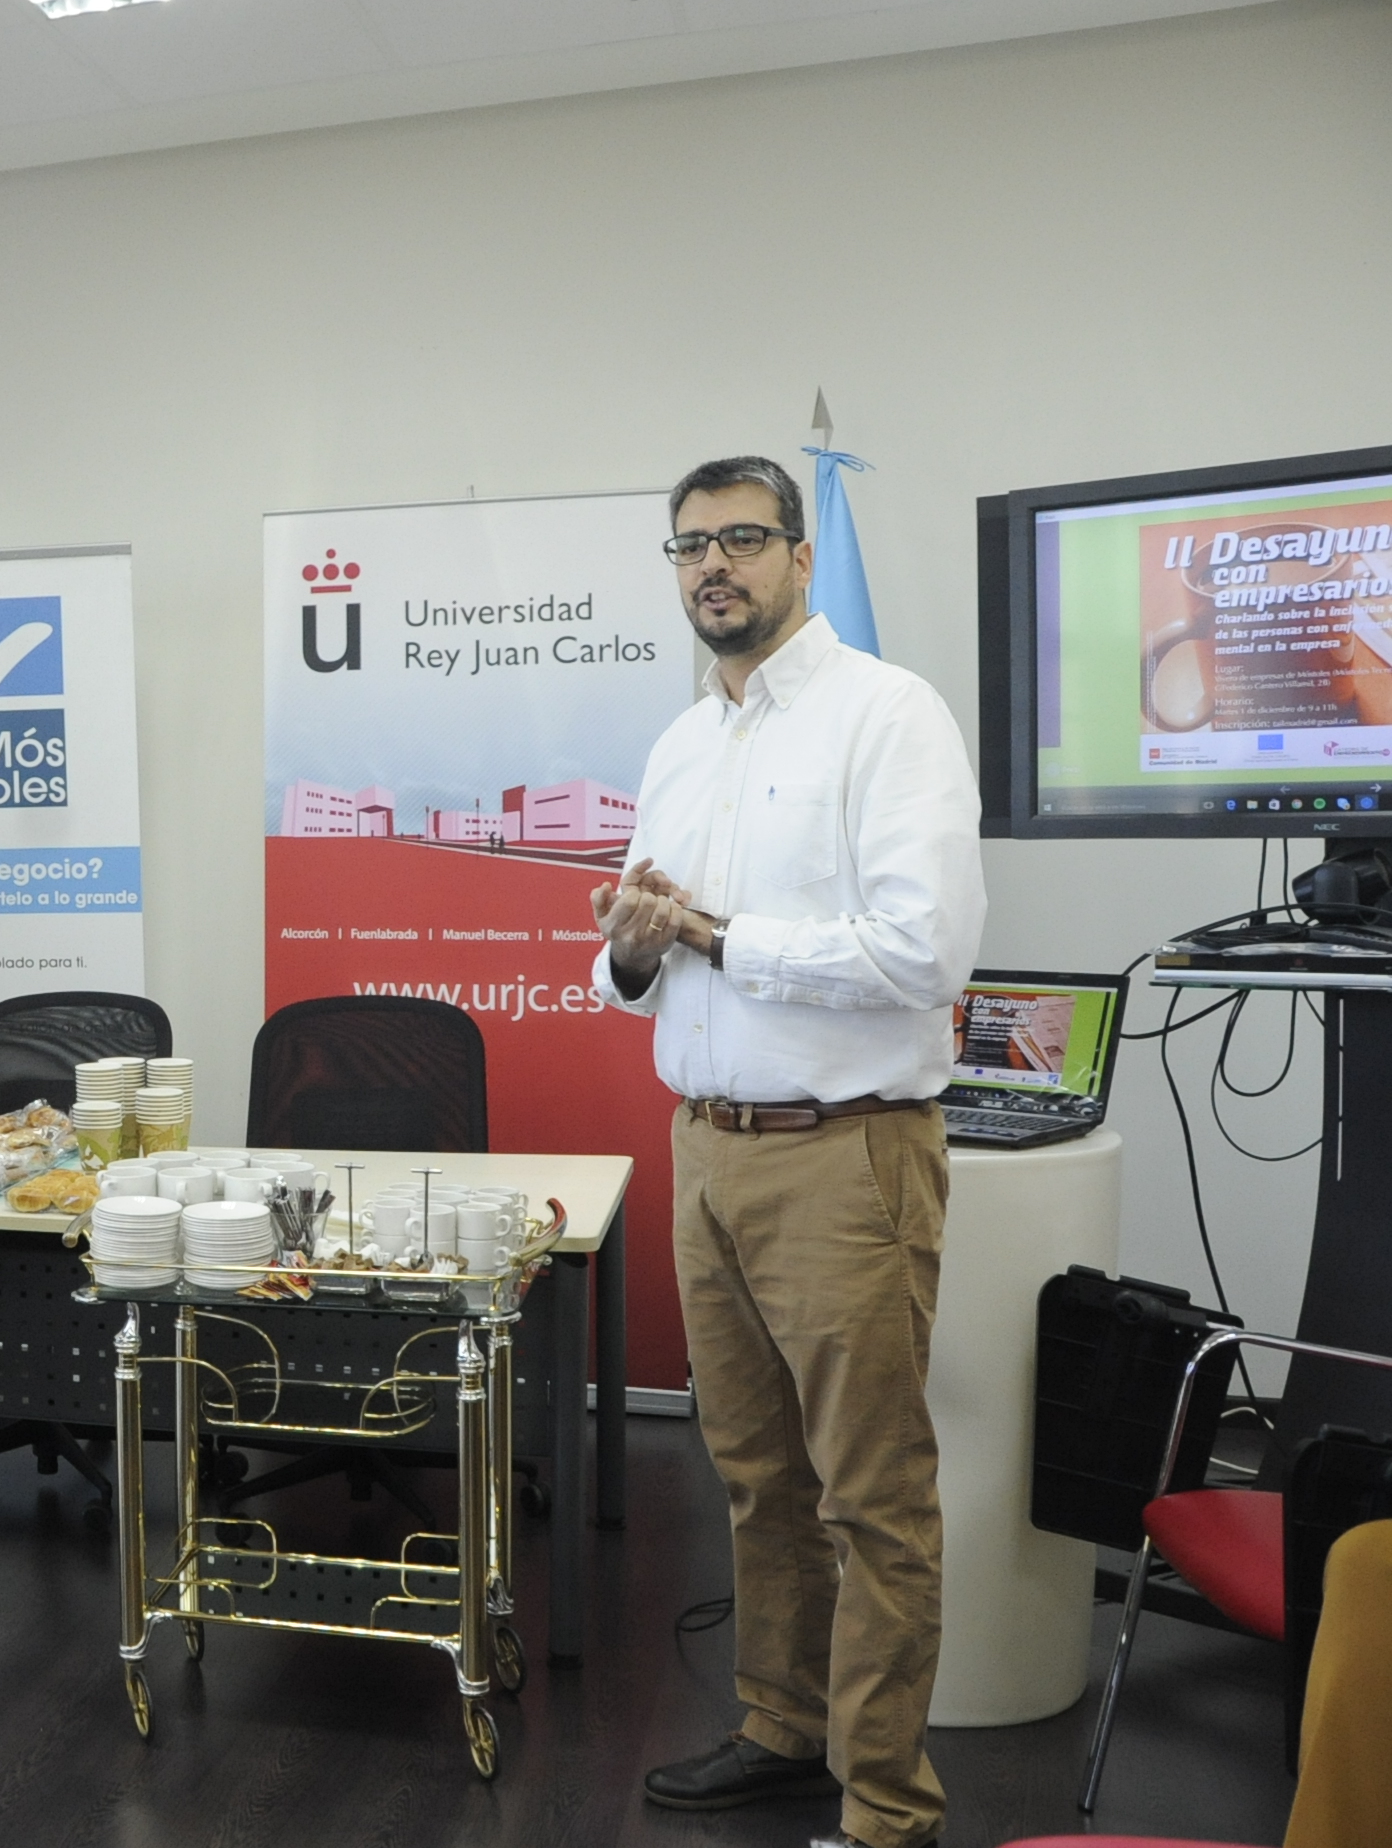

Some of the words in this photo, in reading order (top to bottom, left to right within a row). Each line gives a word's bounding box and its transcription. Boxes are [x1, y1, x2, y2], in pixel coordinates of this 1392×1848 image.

[1209, 523, 1392, 567] Desayun
[1213, 564, 1266, 586] con
[404, 592, 593, 627] Universidad
[1215, 612, 1274, 624] Charlando
[1278, 609, 1310, 621] sobre
[1314, 607, 1325, 617] la
[1215, 629, 1228, 639] de
[1232, 628, 1248, 638] las
[1251, 625, 1303, 640] personas
[1307, 625, 1329, 634] con
[1332, 619, 1392, 634] enfermed
[404, 641, 461, 676] Rey
[470, 638, 540, 676] Juan
[552, 634, 656, 664] Carlos
[1215, 643, 1254, 655] mental
[1257, 644, 1271, 652] en
[1275, 641, 1286, 651] la
[1290, 640, 1340, 653] empresa
[1215, 664, 1244, 675] Lugar:
[1215, 718, 1270, 731] Inscripción:
[1313, 823, 1340, 831] NEC
[38, 893, 49, 905] a
[54, 891, 70, 905] lo
[75, 890, 138, 909] grande
[280, 927, 329, 940] Alcorcón
[350, 927, 418, 941] Fuenlabrada
[442, 928, 485, 941] Manuel
[487, 929, 529, 942] Becerra
[552, 928, 604, 942] Móstoles
[39, 957, 72, 972] para
[76, 955, 87, 969] ti.
[972, 995, 1038, 1011] Desayuno
[971, 1015, 1030, 1026] empresarios
